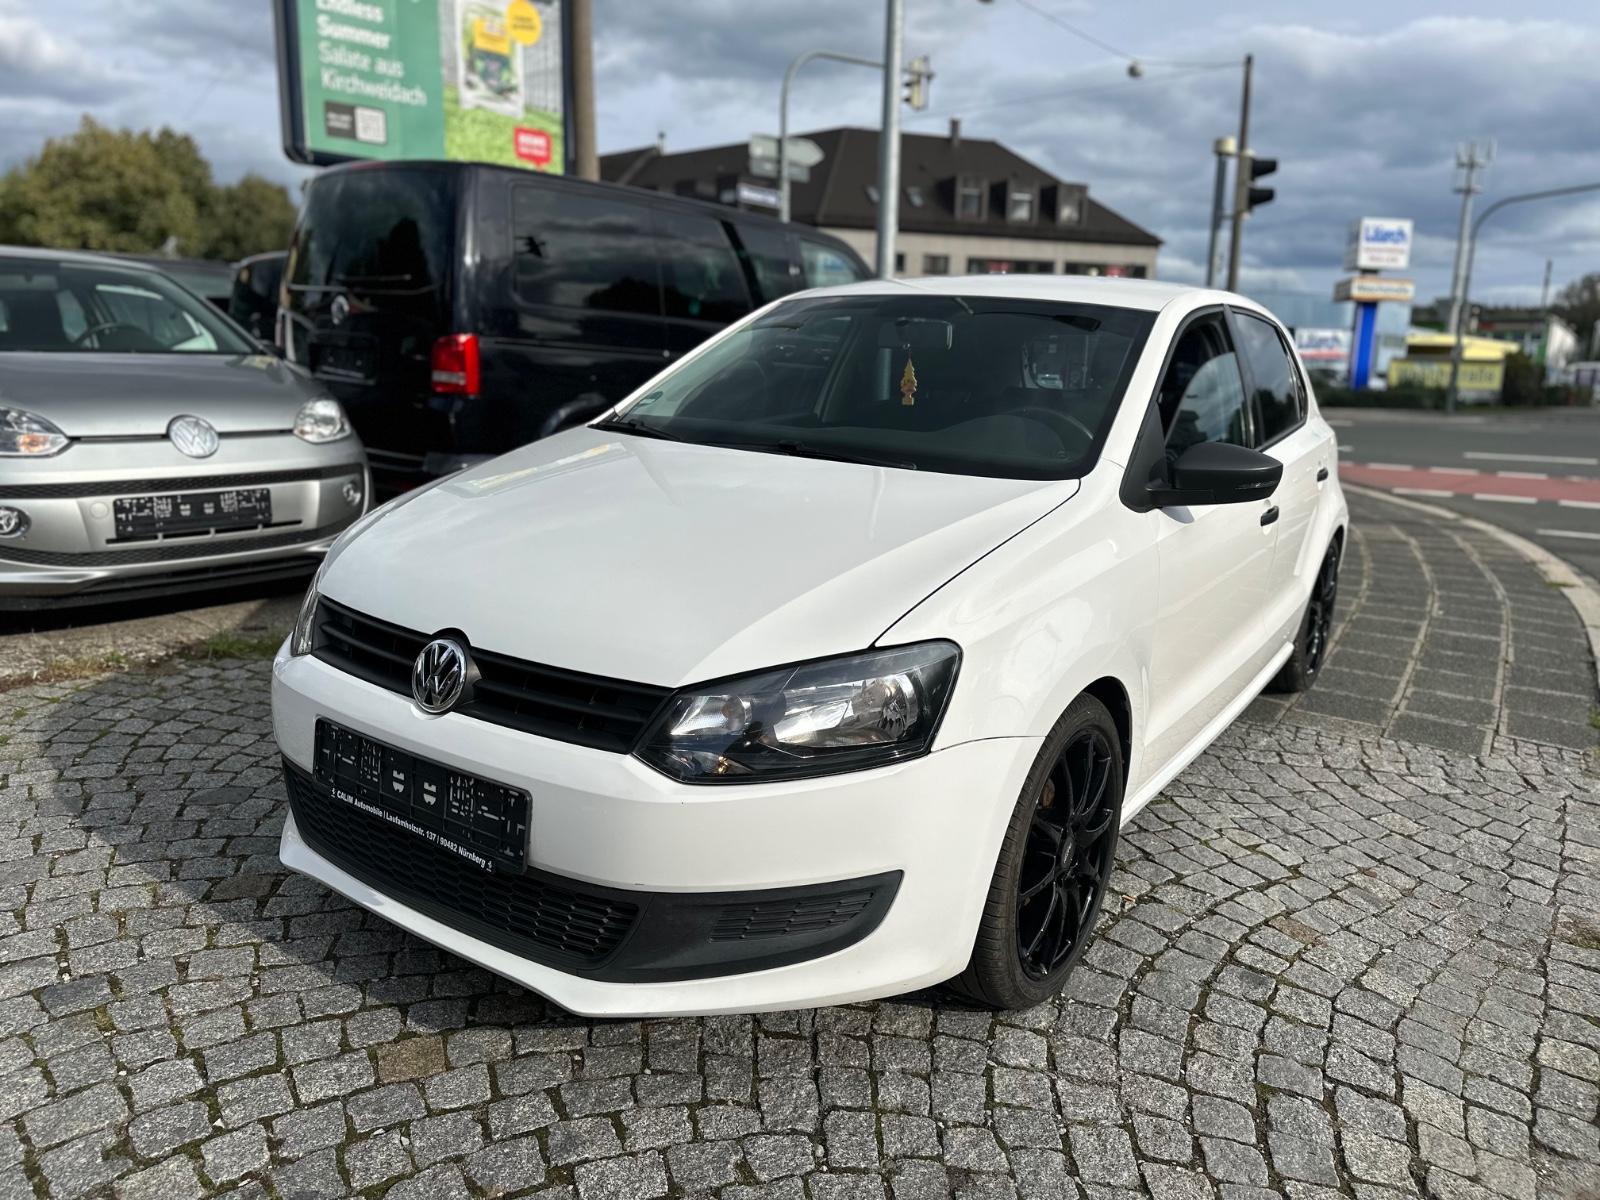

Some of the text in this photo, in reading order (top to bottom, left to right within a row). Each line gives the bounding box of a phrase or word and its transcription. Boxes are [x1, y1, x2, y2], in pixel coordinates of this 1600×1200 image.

[374, 57, 404, 78] aus
[354, 798, 383, 818] Automobile
[426, 830, 436, 842] 137
[440, 836, 458, 853] 90482
[458, 845, 486, 869] Nürnberg
